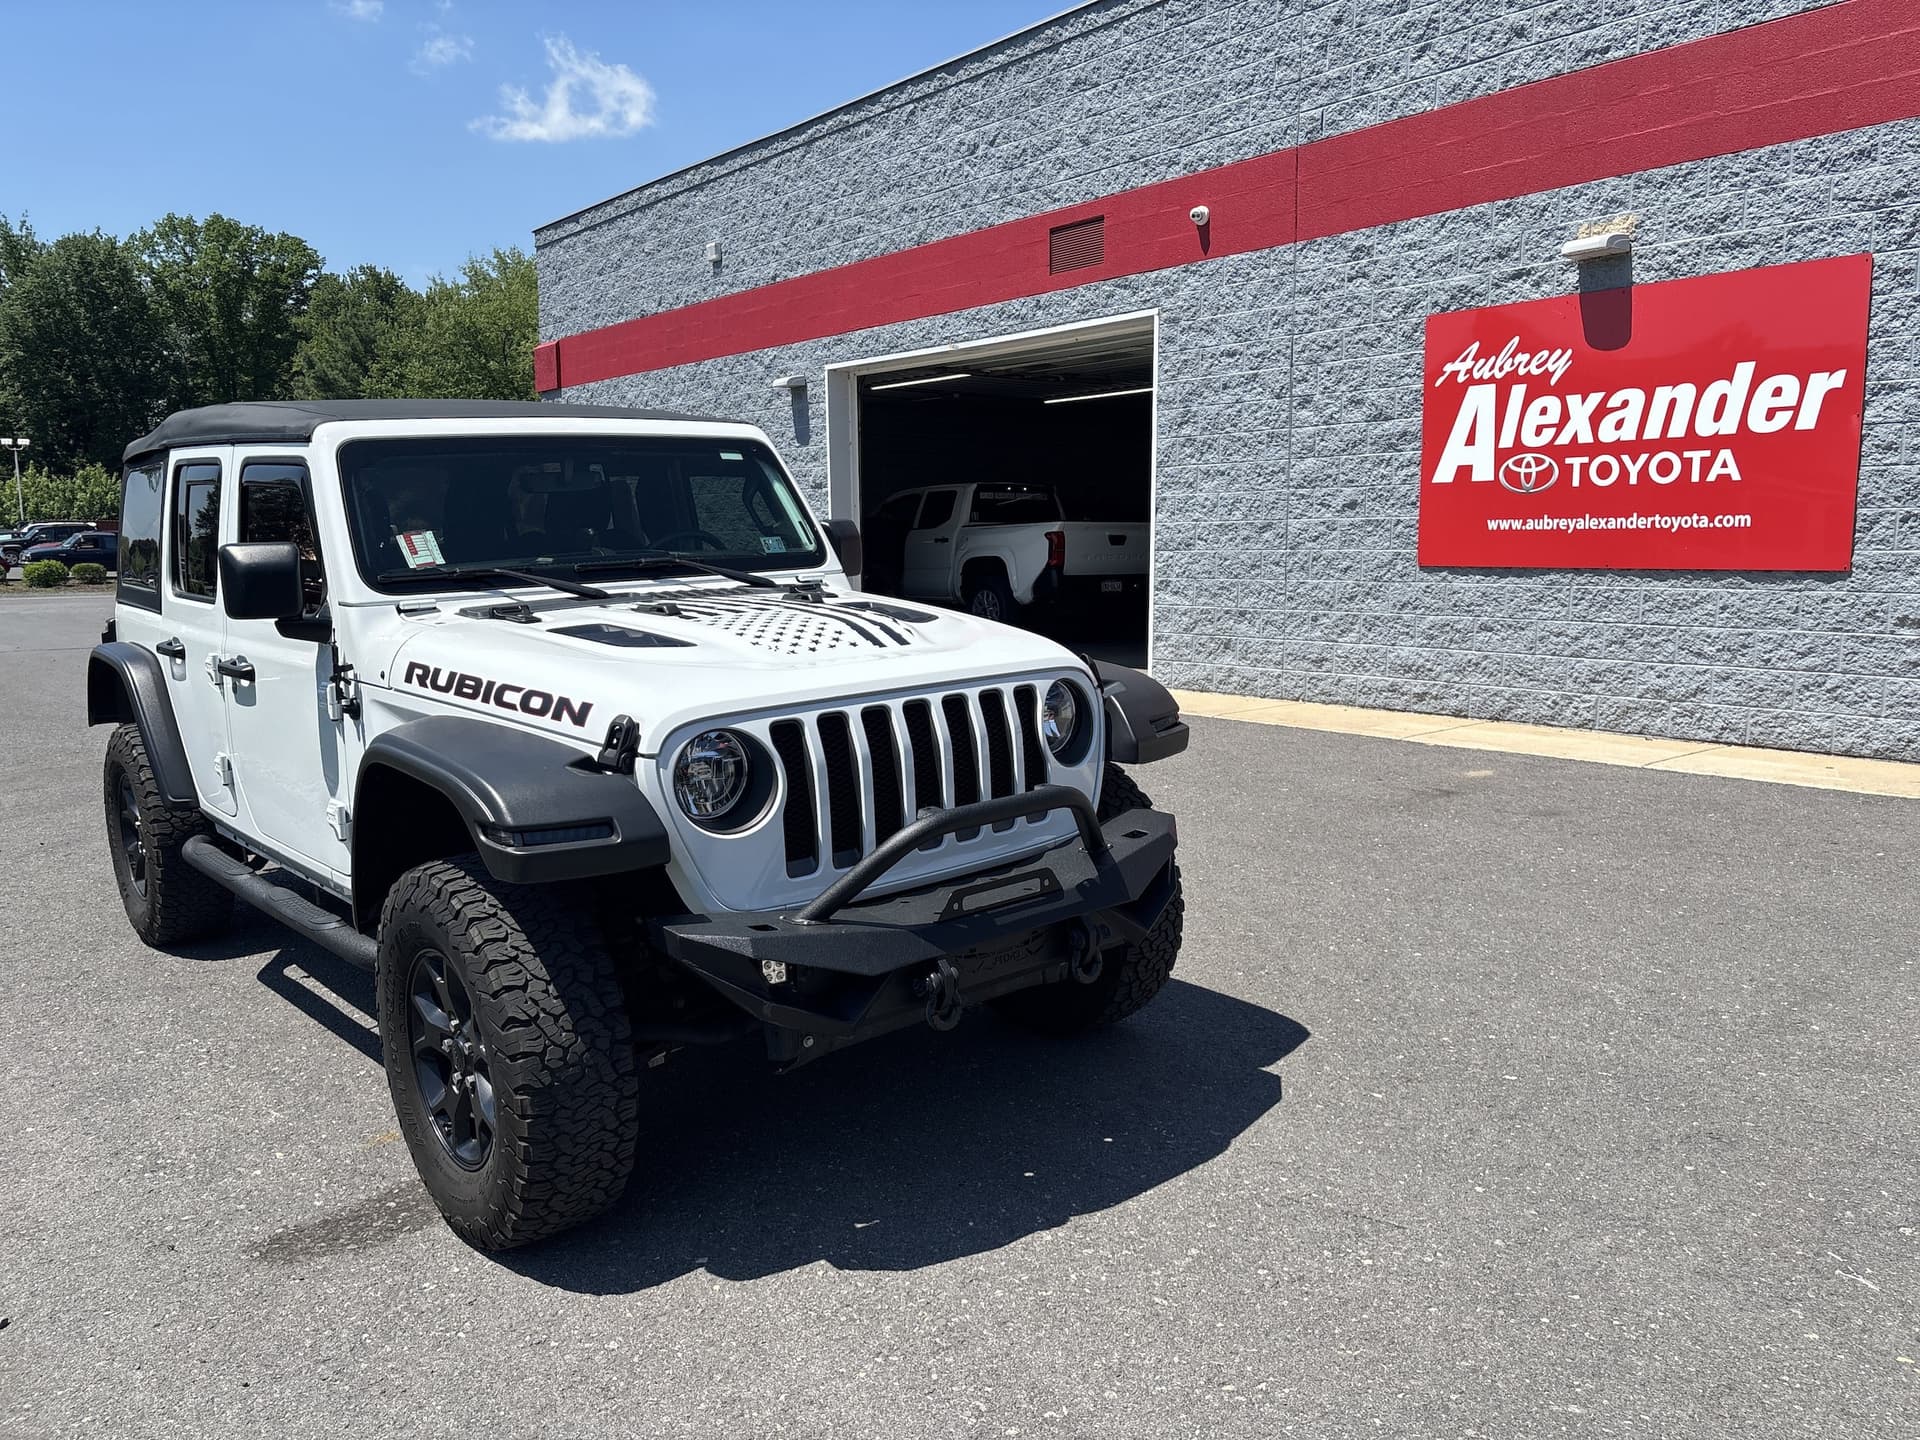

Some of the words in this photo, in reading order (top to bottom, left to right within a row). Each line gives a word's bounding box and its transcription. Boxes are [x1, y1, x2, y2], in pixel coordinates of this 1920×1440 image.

[1434, 335, 1573, 387] Aubrey
[1431, 360, 1847, 484] Alexander
[1565, 448, 1742, 488] TOYOTA
[1486, 512, 1752, 534] www.aubreyalexandertoyota.com
[404, 661, 594, 728] RUBICON
